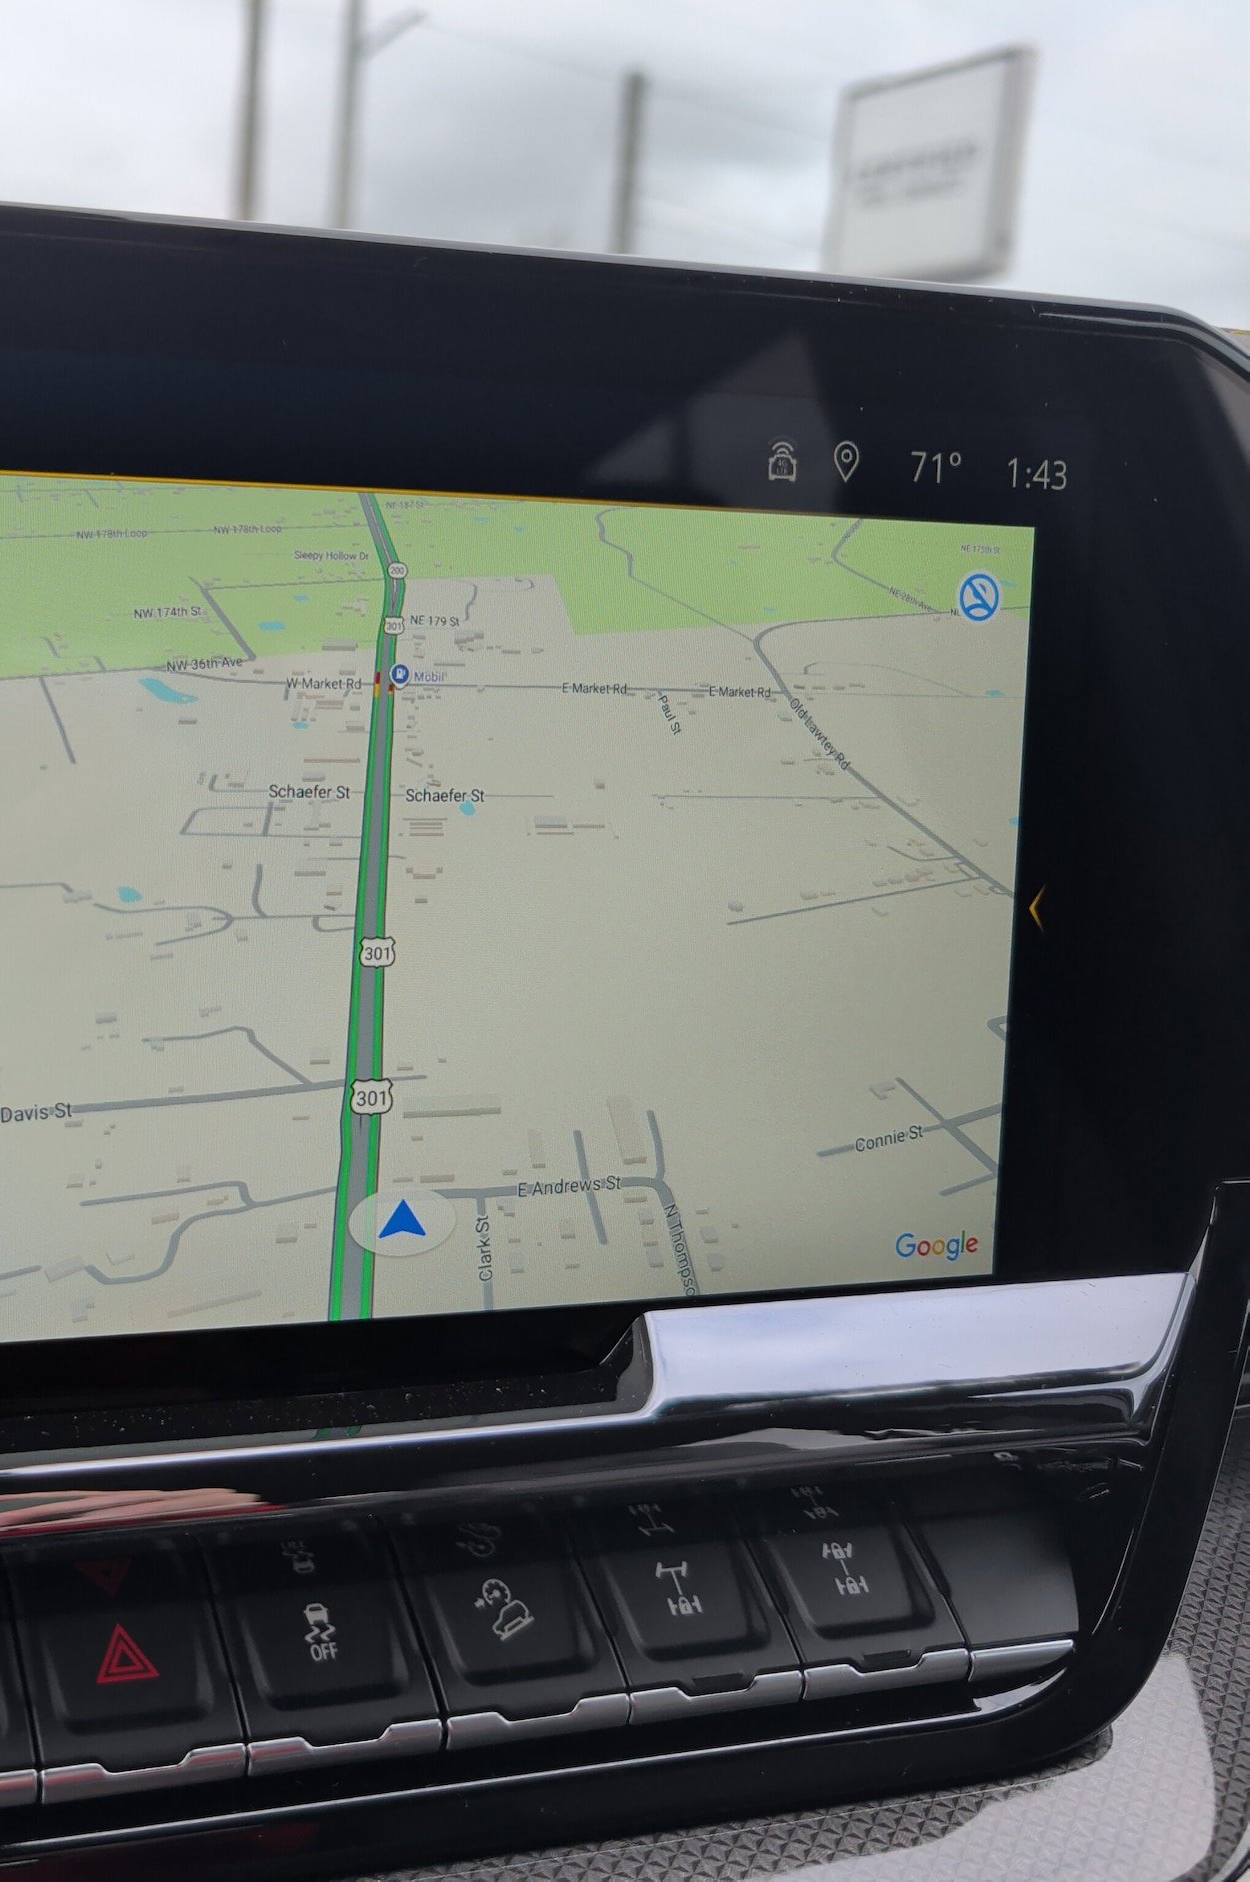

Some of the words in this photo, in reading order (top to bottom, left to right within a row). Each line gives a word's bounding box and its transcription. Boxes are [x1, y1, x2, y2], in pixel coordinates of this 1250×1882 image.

[1007, 457, 1068, 491] 1:43
[76, 530, 95, 540] NW
[96, 529, 123, 539] 178th
[125, 528, 148, 541] Loop
[213, 525, 232, 535] NW
[233, 524, 258, 534] 178th
[260, 523, 282, 535] Loop
[294, 550, 323, 562] Sleepy
[326, 550, 357, 561] Hollow
[359, 551, 369, 560] Dr
[390, 566, 404, 575] 200
[889, 586, 901, 598] NE
[901, 591, 918, 606] 28th
[918, 600, 933, 613] Ave
[134, 608, 155, 619] NW
[157, 606, 188, 618] 174th
[190, 606, 201, 616] St
[386, 621, 401, 631] 301
[410, 615, 425, 625] NE
[428, 616, 446, 627] 179
[449, 617, 460, 626] St
[166, 660, 189, 671] NW
[191, 659, 218, 670] 36th
[219, 657, 243, 668] Ave
[286, 678, 299, 689] W
[301, 677, 343, 690] Market
[345, 678, 362, 689] Rd
[414, 672, 445, 682] Mobil
[562, 682, 569, 693] E
[571, 683, 610, 695] Market
[612, 684, 628, 694] Rd
[708, 686, 716, 696] E
[718, 686, 755, 698] Market
[757, 687, 771, 698] Rd
[659, 695, 676, 723] Paul
[669, 720, 682, 736] St
[790, 698, 808, 719] Old
[804, 716, 838, 757] Lawtey
[834, 752, 850, 771] Rd
[268, 784, 332, 799] Schaefer
[336, 785, 351, 799] St
[405, 788, 467, 803] Schaefer
[470, 789, 485, 802] St
[364, 946, 391, 962] 301
[356, 1089, 388, 1107] 301
[0, 1104, 50, 1124] Davis
[53, 1102, 73, 1118] St
[854, 1130, 906, 1152] Connie
[908, 1124, 924, 1140] St
[517, 1183, 528, 1197] E
[531, 1177, 602, 1196] Andrews
[605, 1175, 621, 1190] St
[664, 1203, 679, 1218] N
[475, 1214, 491, 1233] St
[895, 1230, 979, 1262] Google
[476, 1237, 493, 1282] Clark
[309, 1641, 339, 1662] OFF
